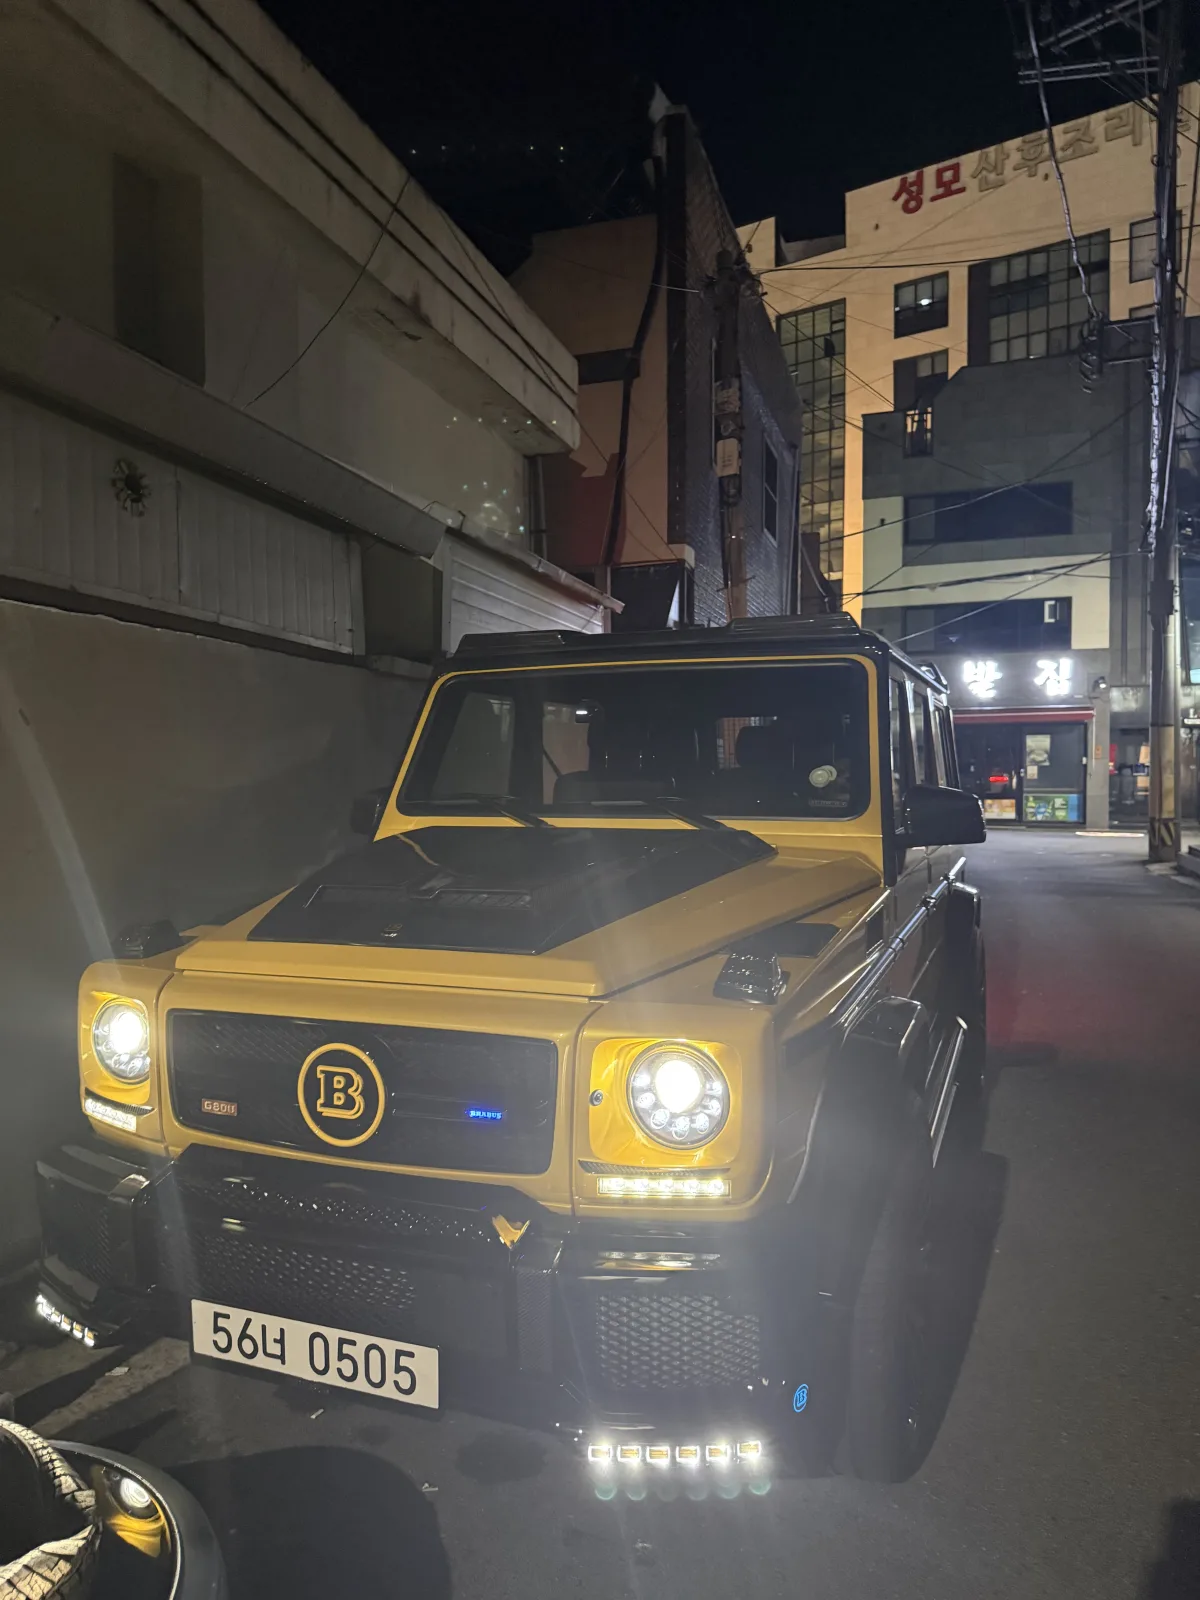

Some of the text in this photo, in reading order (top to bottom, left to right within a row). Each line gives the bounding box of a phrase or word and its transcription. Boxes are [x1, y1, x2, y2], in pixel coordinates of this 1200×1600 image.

[891, 162, 967, 215] 성모
[470, 1110, 502, 1120] BRABUS
[212, 1310, 417, 1396] 56너 0505
